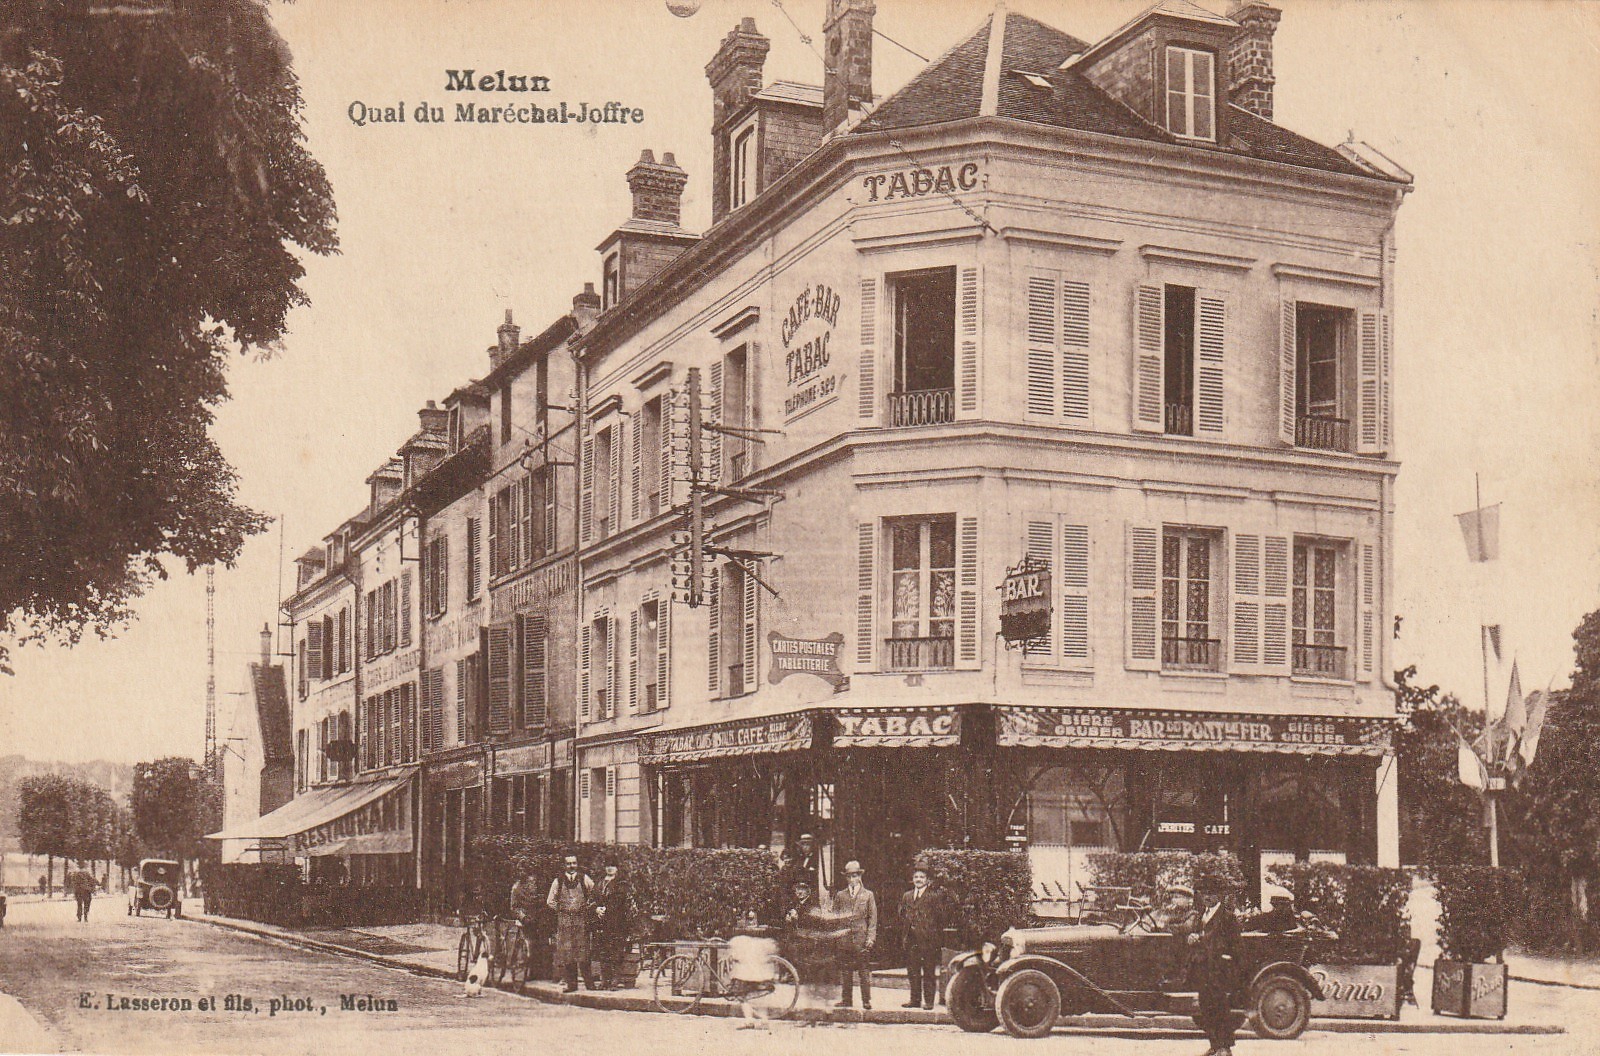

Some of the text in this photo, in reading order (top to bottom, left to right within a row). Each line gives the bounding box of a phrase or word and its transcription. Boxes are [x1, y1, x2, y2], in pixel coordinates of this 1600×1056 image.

[863, 162, 978, 202] TABAC
[785, 330, 830, 387] TABAC
[1006, 574, 1044, 600] BAR
[772, 639, 835, 656] CARTES POSTALES
[777, 657, 830, 672] TABLETTERIE
[837, 715, 953, 736] TABAC
[1129, 719, 1165, 739] BAR
[1240, 721, 1273, 742] FER
